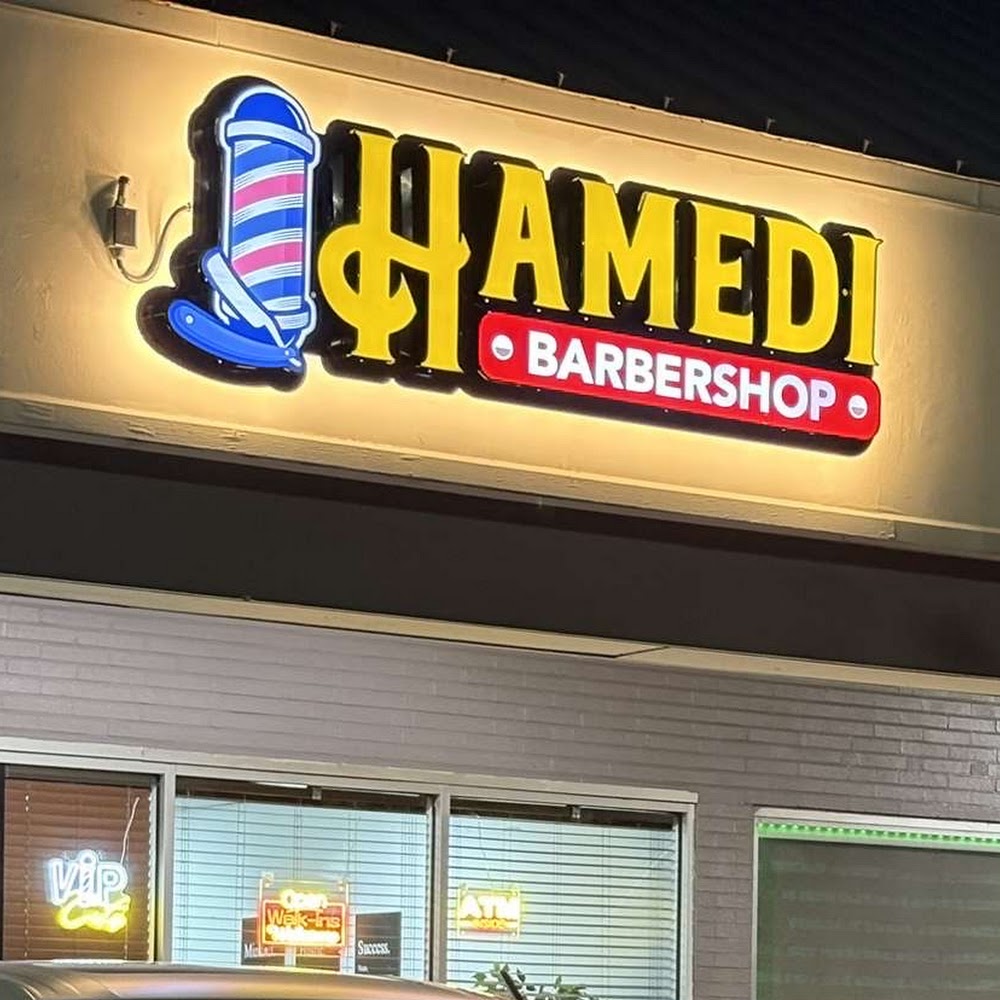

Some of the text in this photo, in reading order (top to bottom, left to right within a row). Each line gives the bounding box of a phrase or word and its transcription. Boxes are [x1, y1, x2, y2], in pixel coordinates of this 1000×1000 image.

[318, 130, 883, 373] HAMEDI
[527, 330, 837, 421] BARBERSHOP
[460, 895, 518, 919] ATM
